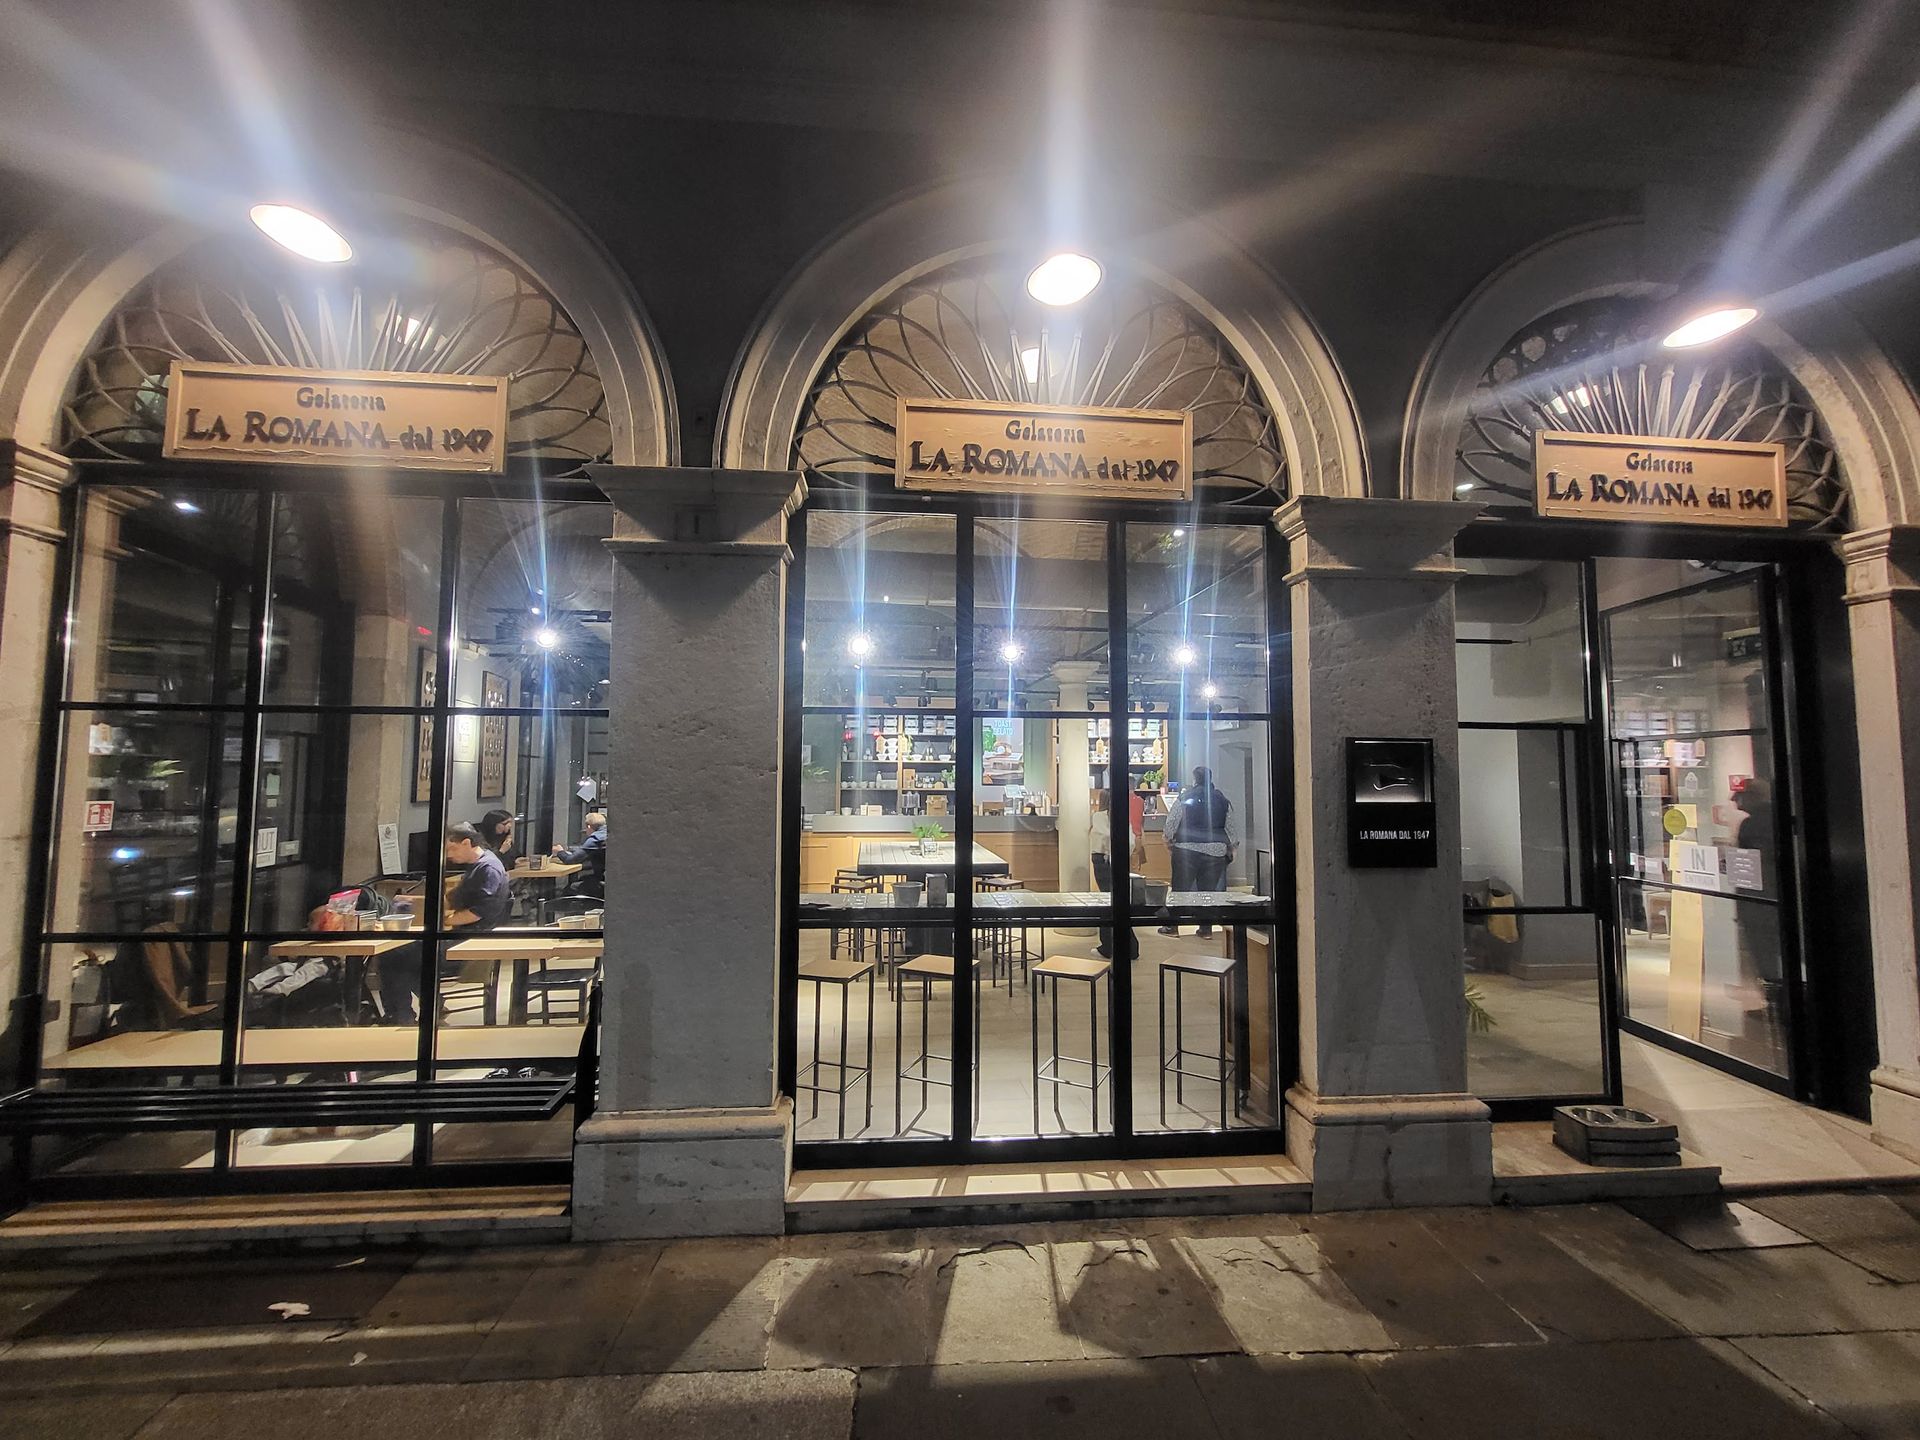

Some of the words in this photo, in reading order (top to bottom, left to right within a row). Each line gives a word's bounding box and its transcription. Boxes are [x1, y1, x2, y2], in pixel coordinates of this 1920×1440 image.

[297, 386, 386, 411] Gelateria
[184, 407, 231, 441] LA
[243, 411, 391, 449] ROMANA
[400, 425, 433, 451] dal
[441, 427, 495, 453] 1947
[1005, 419, 1086, 444] Gelateria
[909, 440, 952, 472] LA
[961, 443, 1090, 480] ROMANA
[1626, 452, 1693, 474] Gelateria
[1546, 471, 1583, 501] LA
[1589, 474, 1700, 508] ROMANA
[1707, 486, 1731, 510] dal
[1360, 830, 1369, 839] LA
[1369, 830, 1398, 840] ROMANA
[1399, 830, 1412, 840] DAL
[1413, 830, 1430, 840] 1947
[1691, 847, 1706, 871] IN
